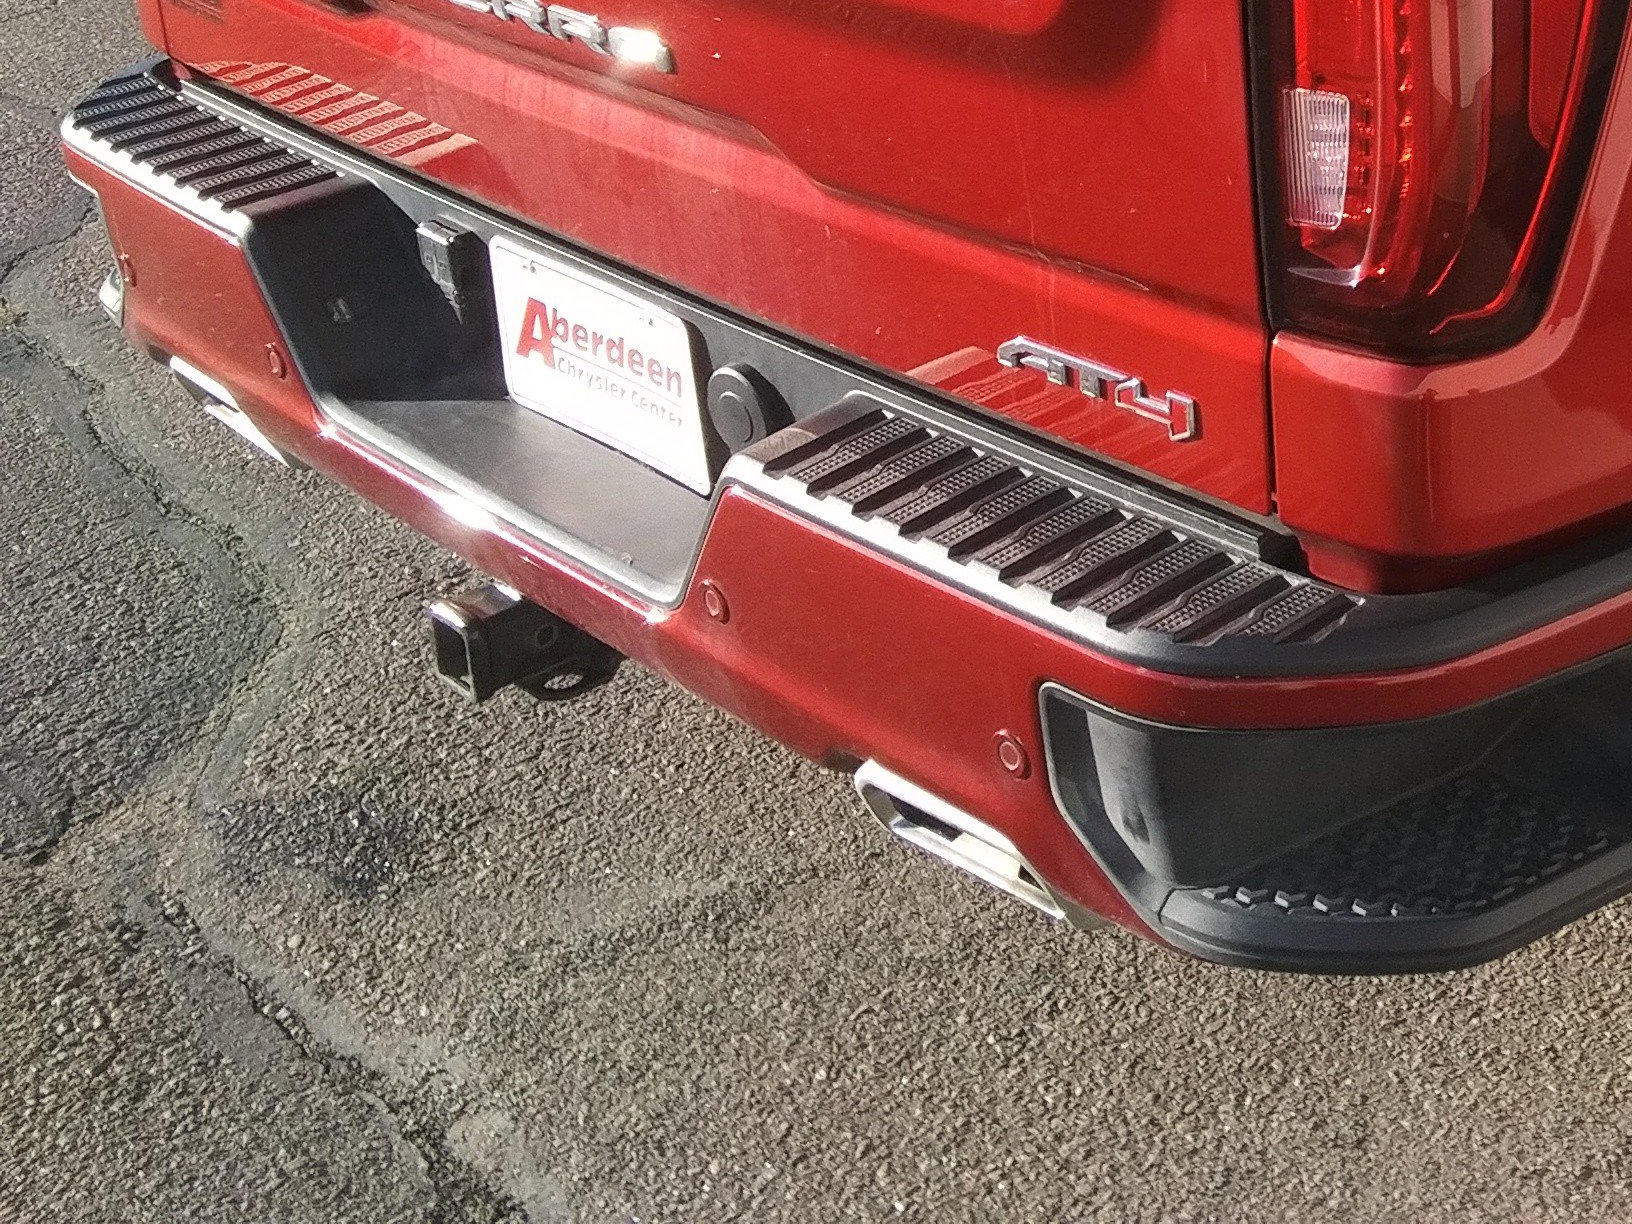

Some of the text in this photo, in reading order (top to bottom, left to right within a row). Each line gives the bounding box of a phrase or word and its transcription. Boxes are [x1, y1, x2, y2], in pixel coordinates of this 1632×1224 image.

[515, 296, 682, 398] Aberdeen
[557, 356, 683, 427] Chrysler Center
[997, 335, 1196, 442] AT4
